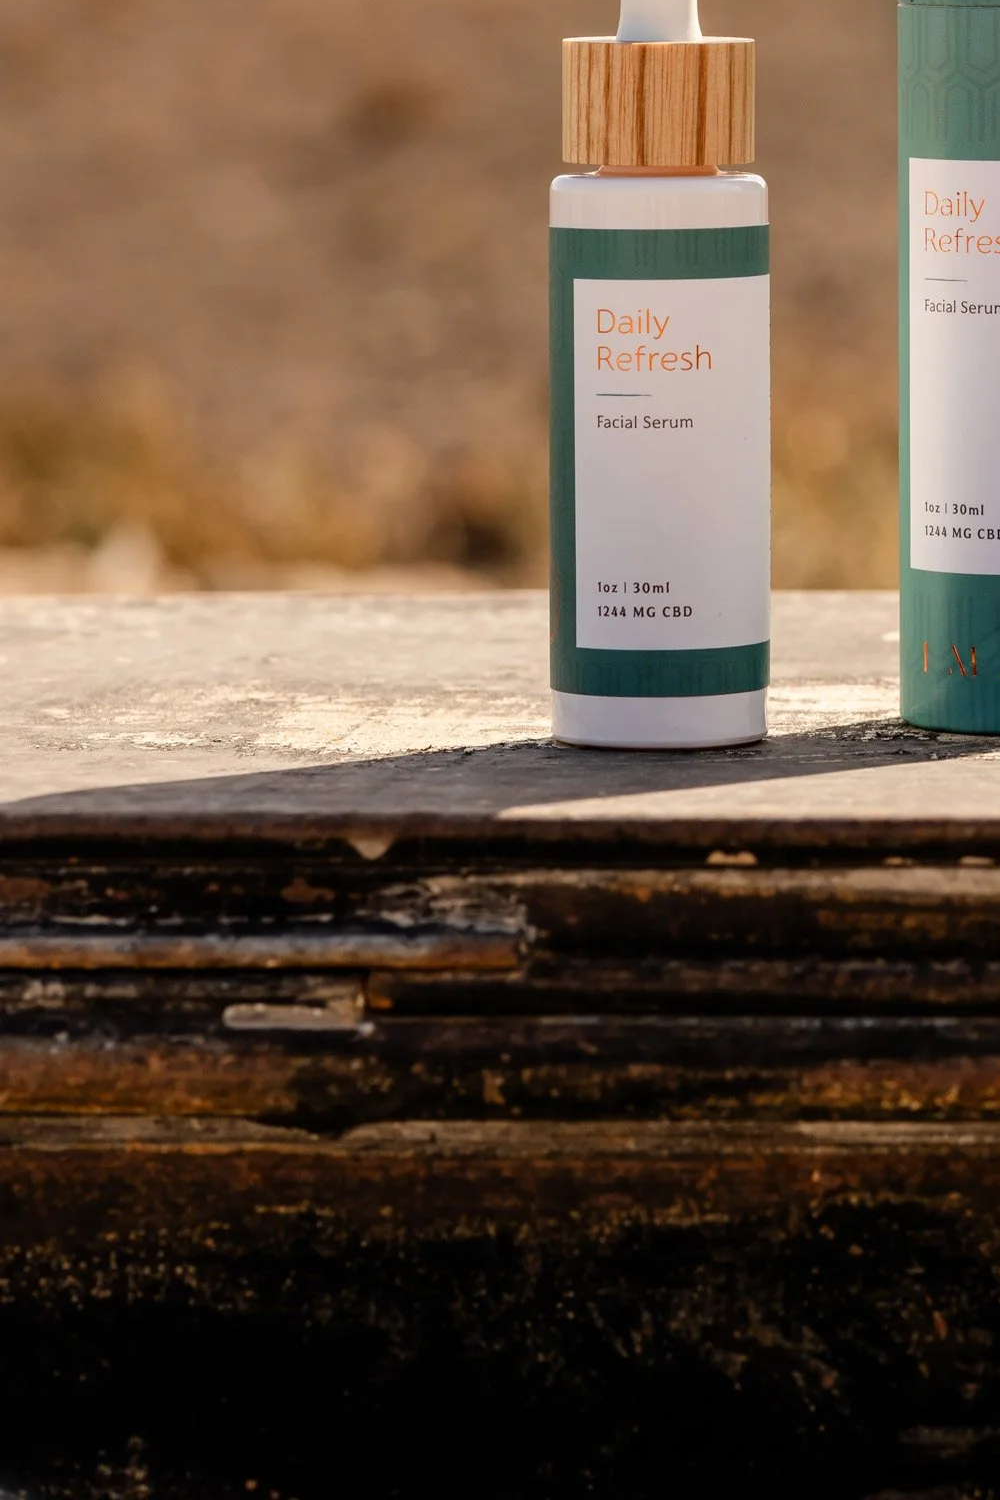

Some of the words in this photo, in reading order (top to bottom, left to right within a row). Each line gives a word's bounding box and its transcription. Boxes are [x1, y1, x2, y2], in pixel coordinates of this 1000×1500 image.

[924, 190, 986, 223] Daily
[924, 298, 957, 314] Facial
[596, 308, 671, 340] Daily
[596, 344, 713, 372] Refresh
[596, 414, 638, 429] Facial
[642, 414, 694, 429] Serum
[924, 500, 941, 514] 1oz
[951, 503, 985, 517] 30ml
[924, 524, 948, 538] 1244
[951, 527, 973, 540] MG
[597, 581, 618, 594] 1oz
[632, 582, 671, 595] 30ml
[597, 605, 627, 618] 1244
[632, 606, 656, 619] MG
[661, 606, 693, 619] CBD
